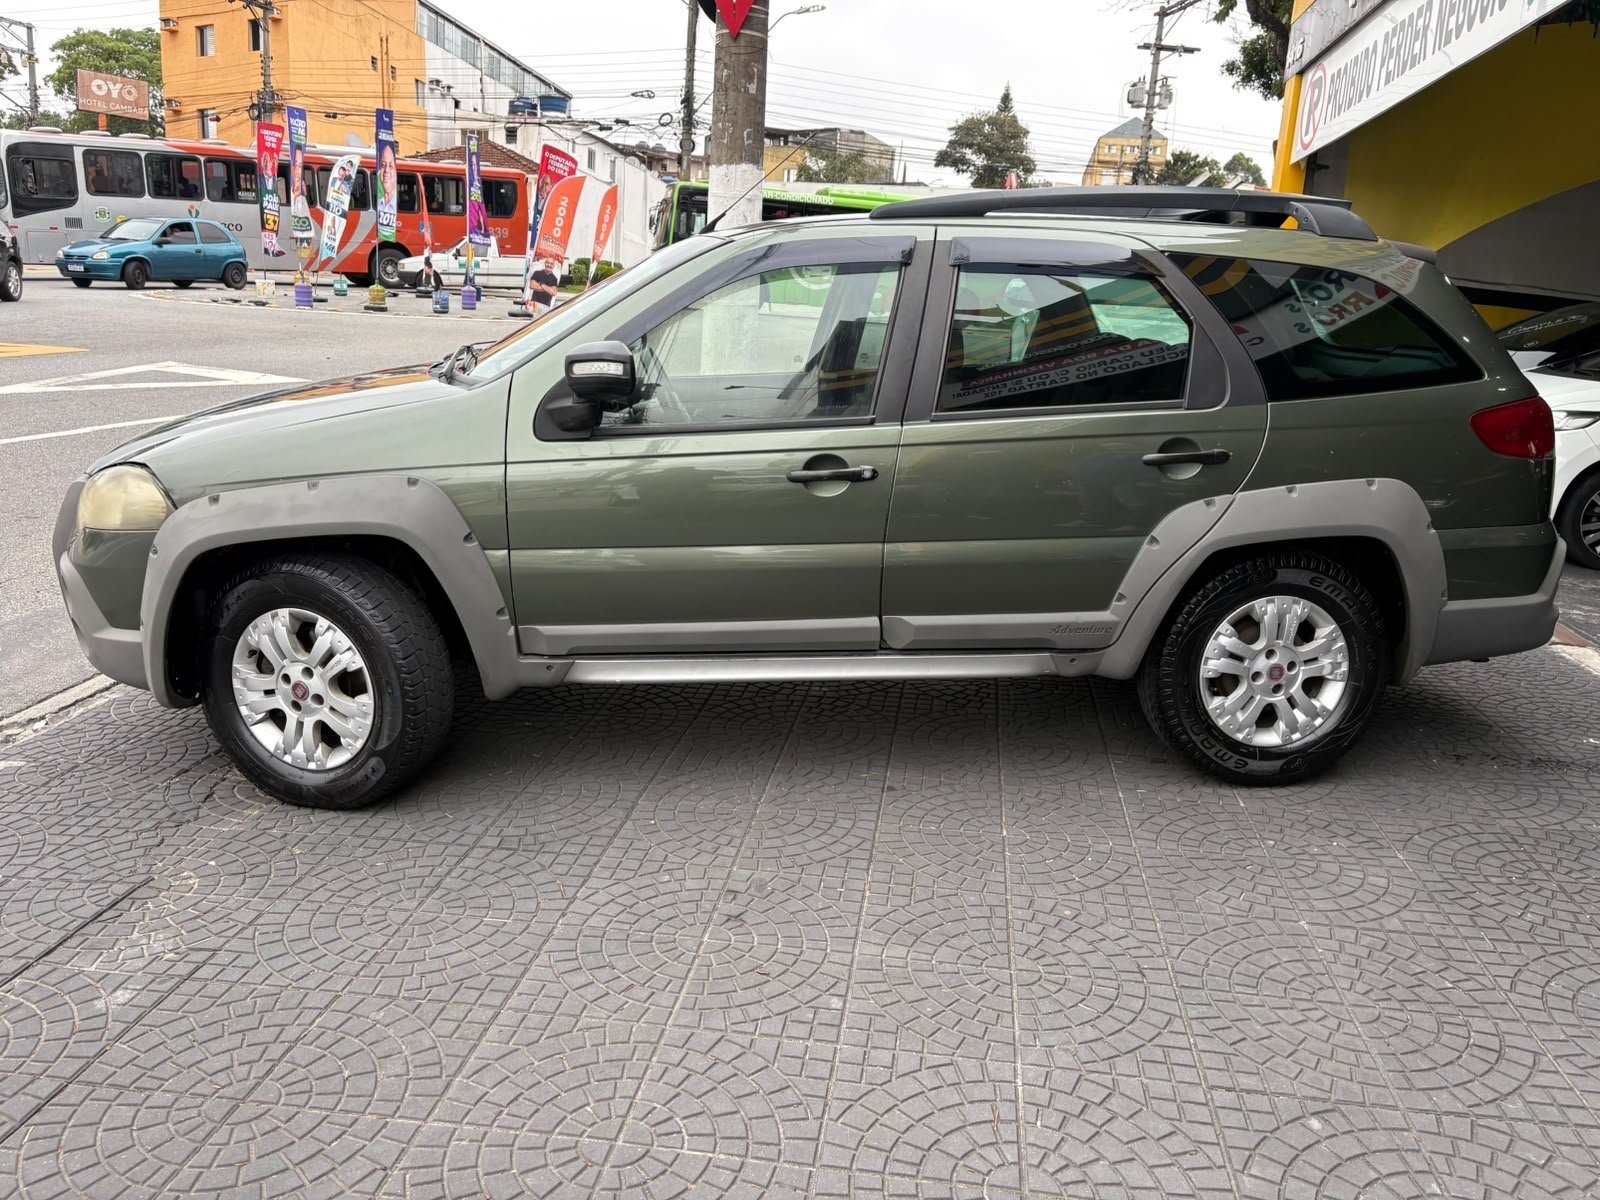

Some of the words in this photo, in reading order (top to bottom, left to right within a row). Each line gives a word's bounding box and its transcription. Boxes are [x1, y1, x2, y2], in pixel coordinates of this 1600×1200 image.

[1323, 39, 1378, 126] PROIBIDO
[1376, 1, 1434, 92] PERDER
[91, 79, 138, 102] OYO
[80, 98, 107, 110] HOTEL
[548, 159, 570, 171] FEDERAL
[763, 190, 834, 206] AR-CONDICIONADO
[553, 196, 569, 238] 2000
[599, 204, 612, 241] 2000
[1048, 624, 1113, 636] Adventure
